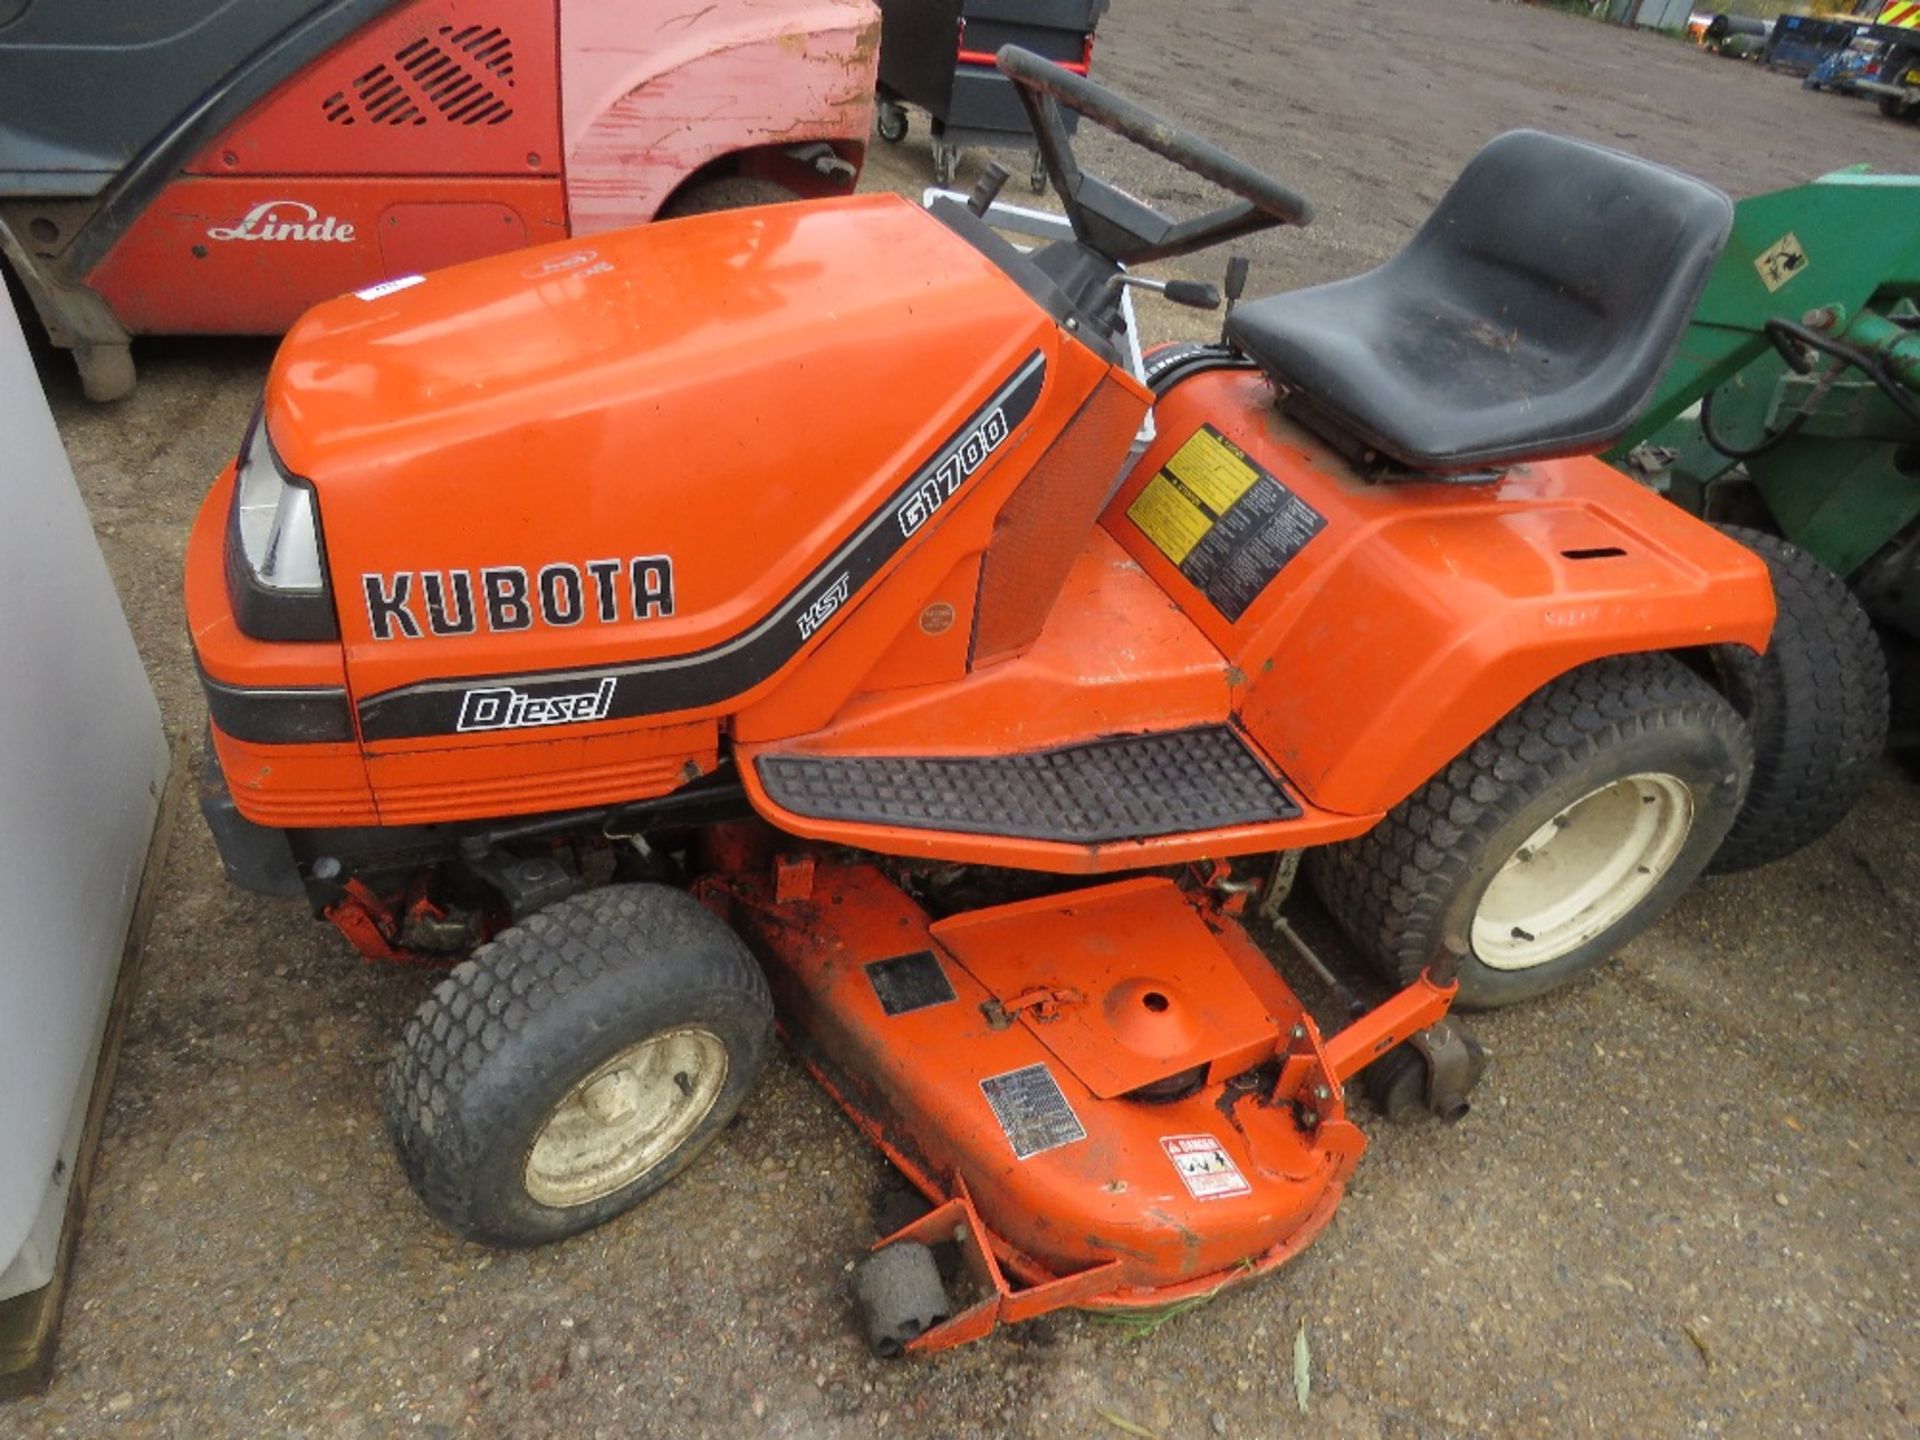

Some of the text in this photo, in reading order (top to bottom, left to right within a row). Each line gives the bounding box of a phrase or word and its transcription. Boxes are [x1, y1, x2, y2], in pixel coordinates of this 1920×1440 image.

[207, 200, 355, 242] Linde
[898, 407, 1008, 537] G1700
[362, 554, 675, 640] KUBOTA
[796, 572, 849, 640] HST
[456, 677, 617, 732] Diesel
